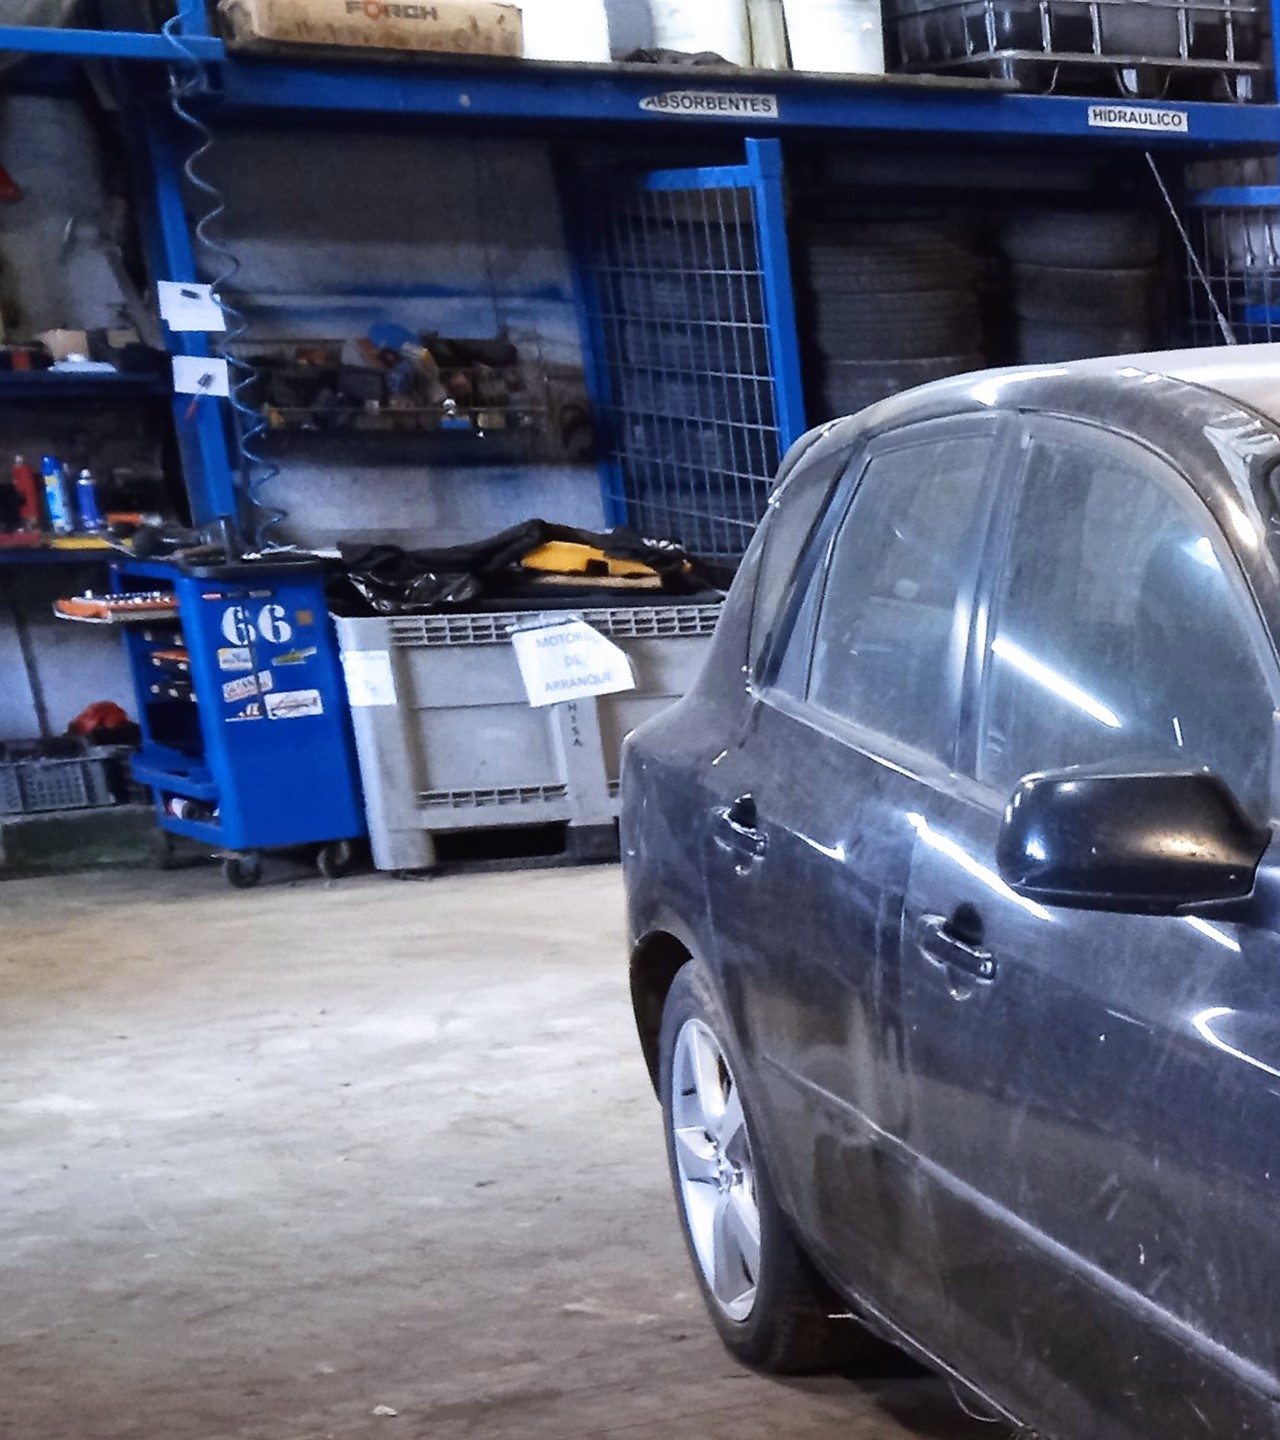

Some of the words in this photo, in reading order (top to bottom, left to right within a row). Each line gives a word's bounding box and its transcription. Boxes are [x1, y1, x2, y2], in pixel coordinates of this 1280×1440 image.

[645, 95, 772, 112] ABSORBENTES
[1092, 109, 1183, 127] HIDRAULICO
[222, 604, 293, 646] 66
